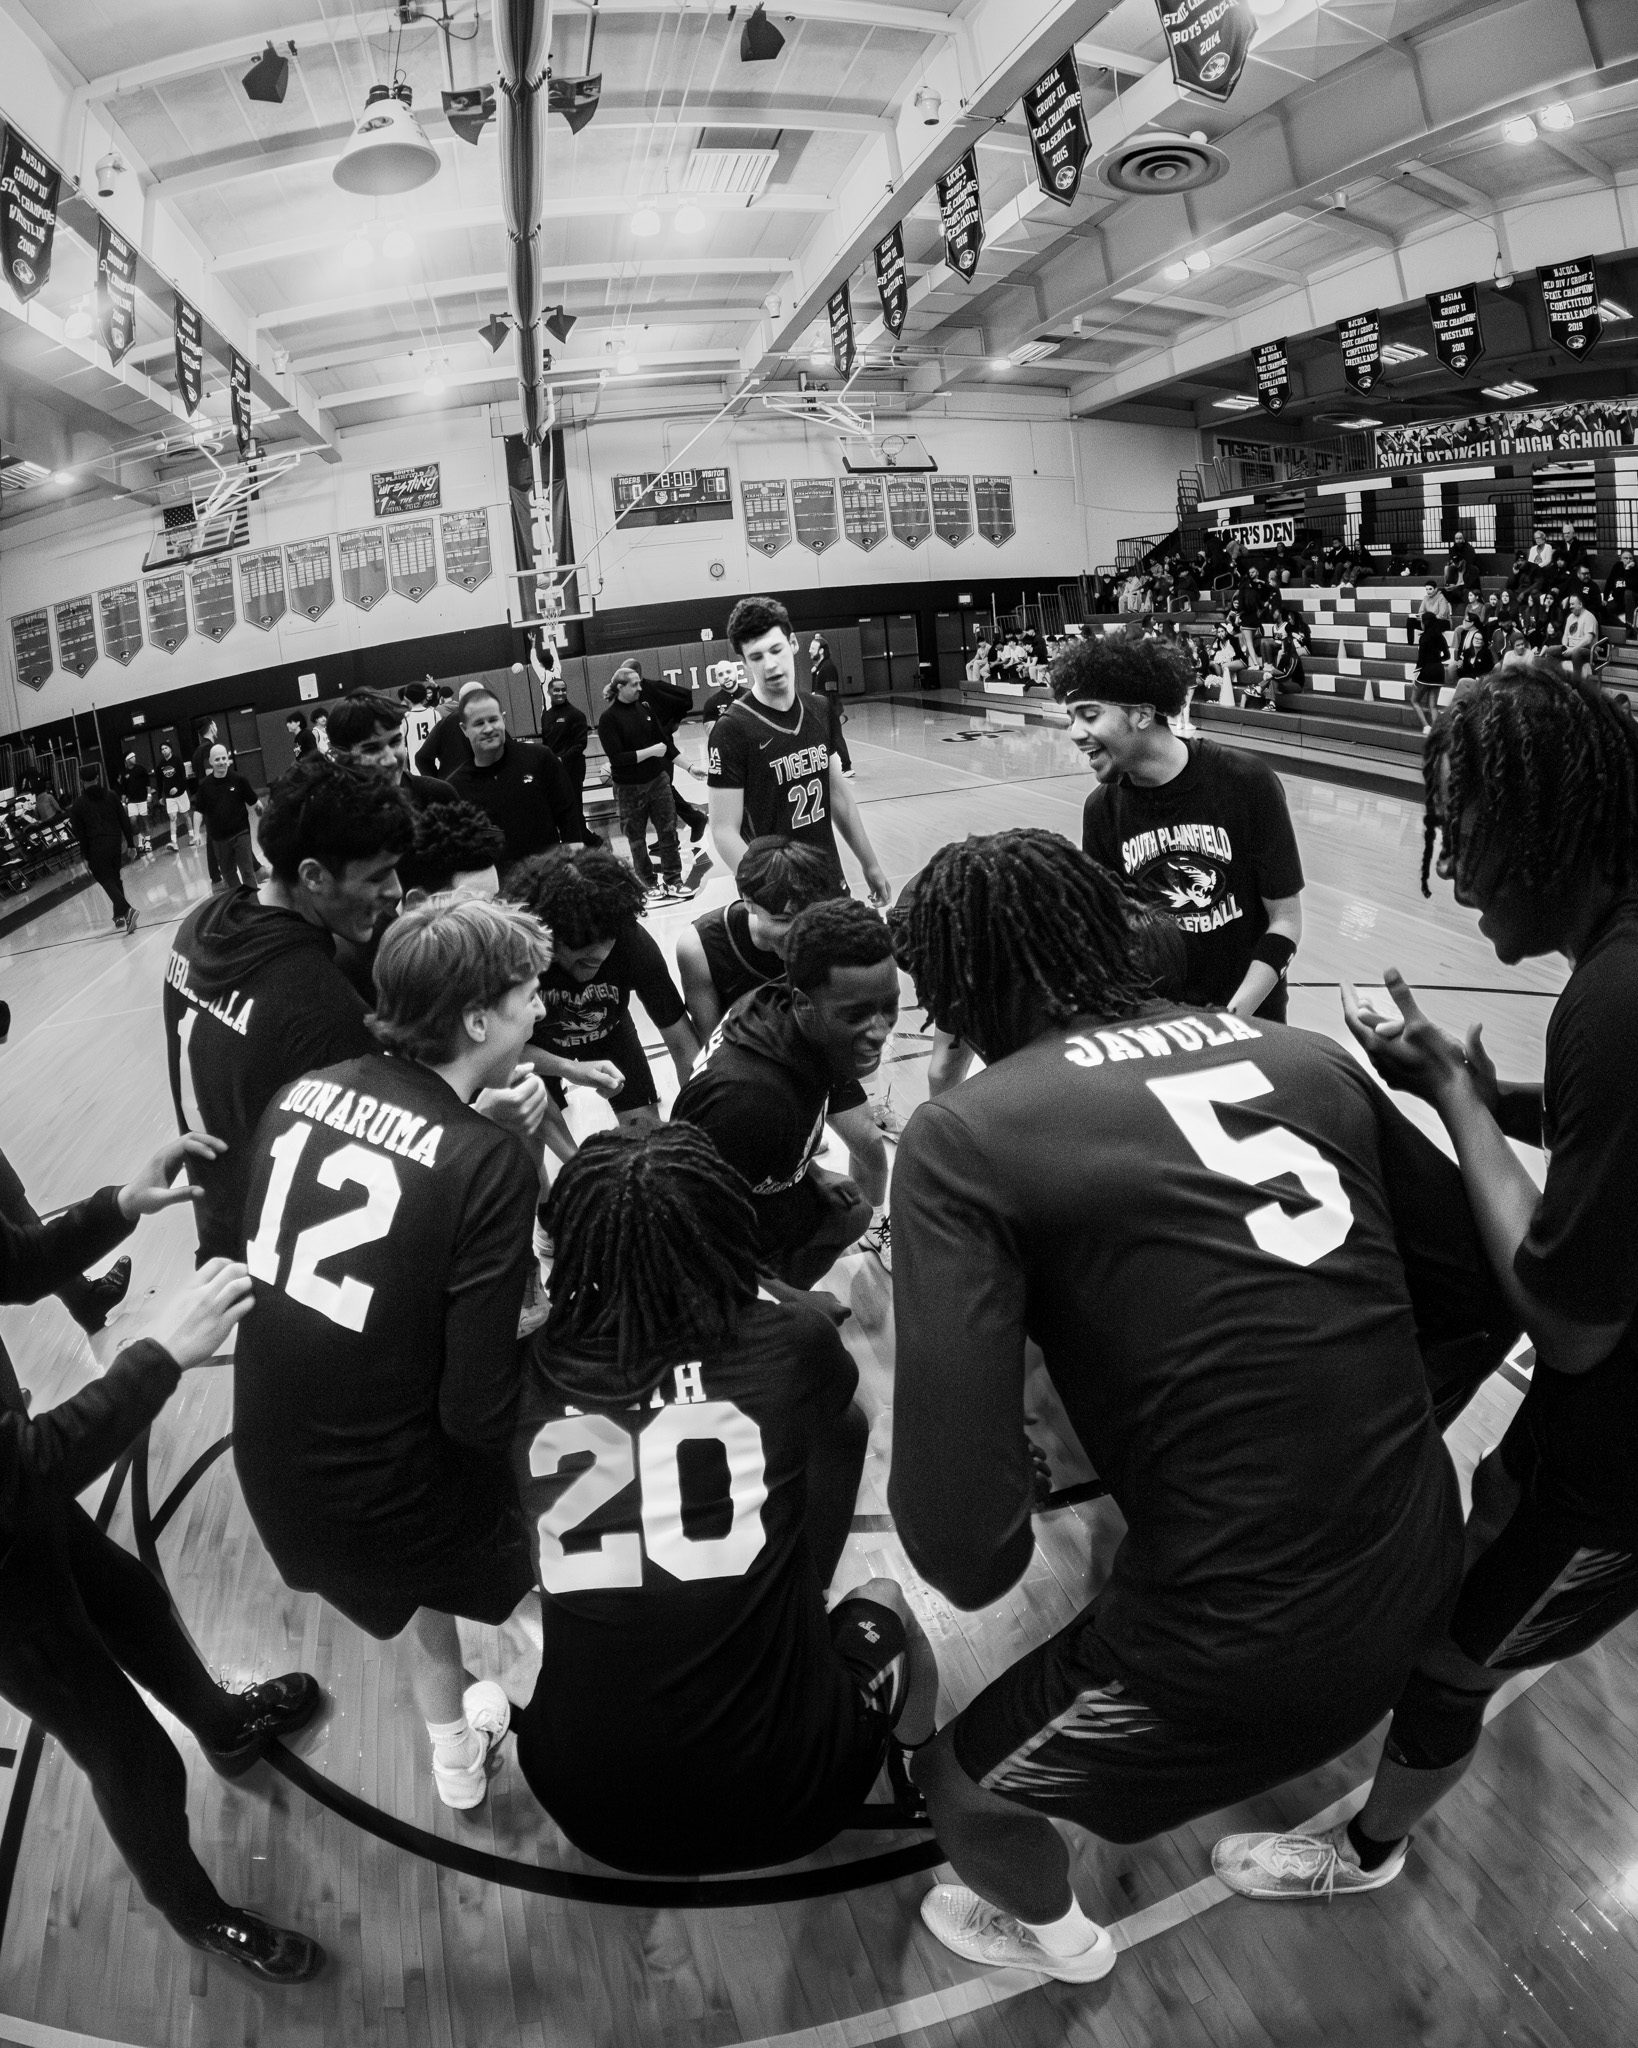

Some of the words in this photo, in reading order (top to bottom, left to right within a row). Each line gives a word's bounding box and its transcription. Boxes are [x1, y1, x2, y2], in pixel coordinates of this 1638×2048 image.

[1172, 20, 1202, 46] BOYS
[1200, 30, 1221, 56] 2014
[1036, 91, 1057, 118] GROUP
[1052, 145, 1069, 168] 2015
[13, 166, 38, 193] GROUP
[17, 235, 36, 258] 2006
[1440, 304, 1460, 316] GROUP
[1568, 321, 1584, 332] 2019
[1452, 342, 1466, 353] 2019
[1380, 451, 1422, 468] SOUTH
[1516, 434, 1553, 454] HIGH
[1559, 428, 1622, 450] SCHOOL
[619, 477, 640, 485] TIGERS
[701, 470, 725, 478] VISITOR
[389, 521, 431, 534] WRESTLING
[443, 511, 485, 525] BASEBALL
[340, 530, 381, 543] WRESTLING
[1262, 521, 1292, 543] DEN
[416, 722, 429, 740] 13
[769, 744, 829, 785] TIGERS
[787, 778, 826, 829] 22
[1121, 829, 1160, 876] SOUTH
[1157, 823, 1233, 864] PLAINFIELD
[1064, 1012, 1263, 1068] JAWULA
[280, 1079, 445, 1168] DONARUMA
[1145, 1059, 1354, 1267] 5
[246, 1121, 402, 1333] 12
[529, 1401, 769, 1595] 20
